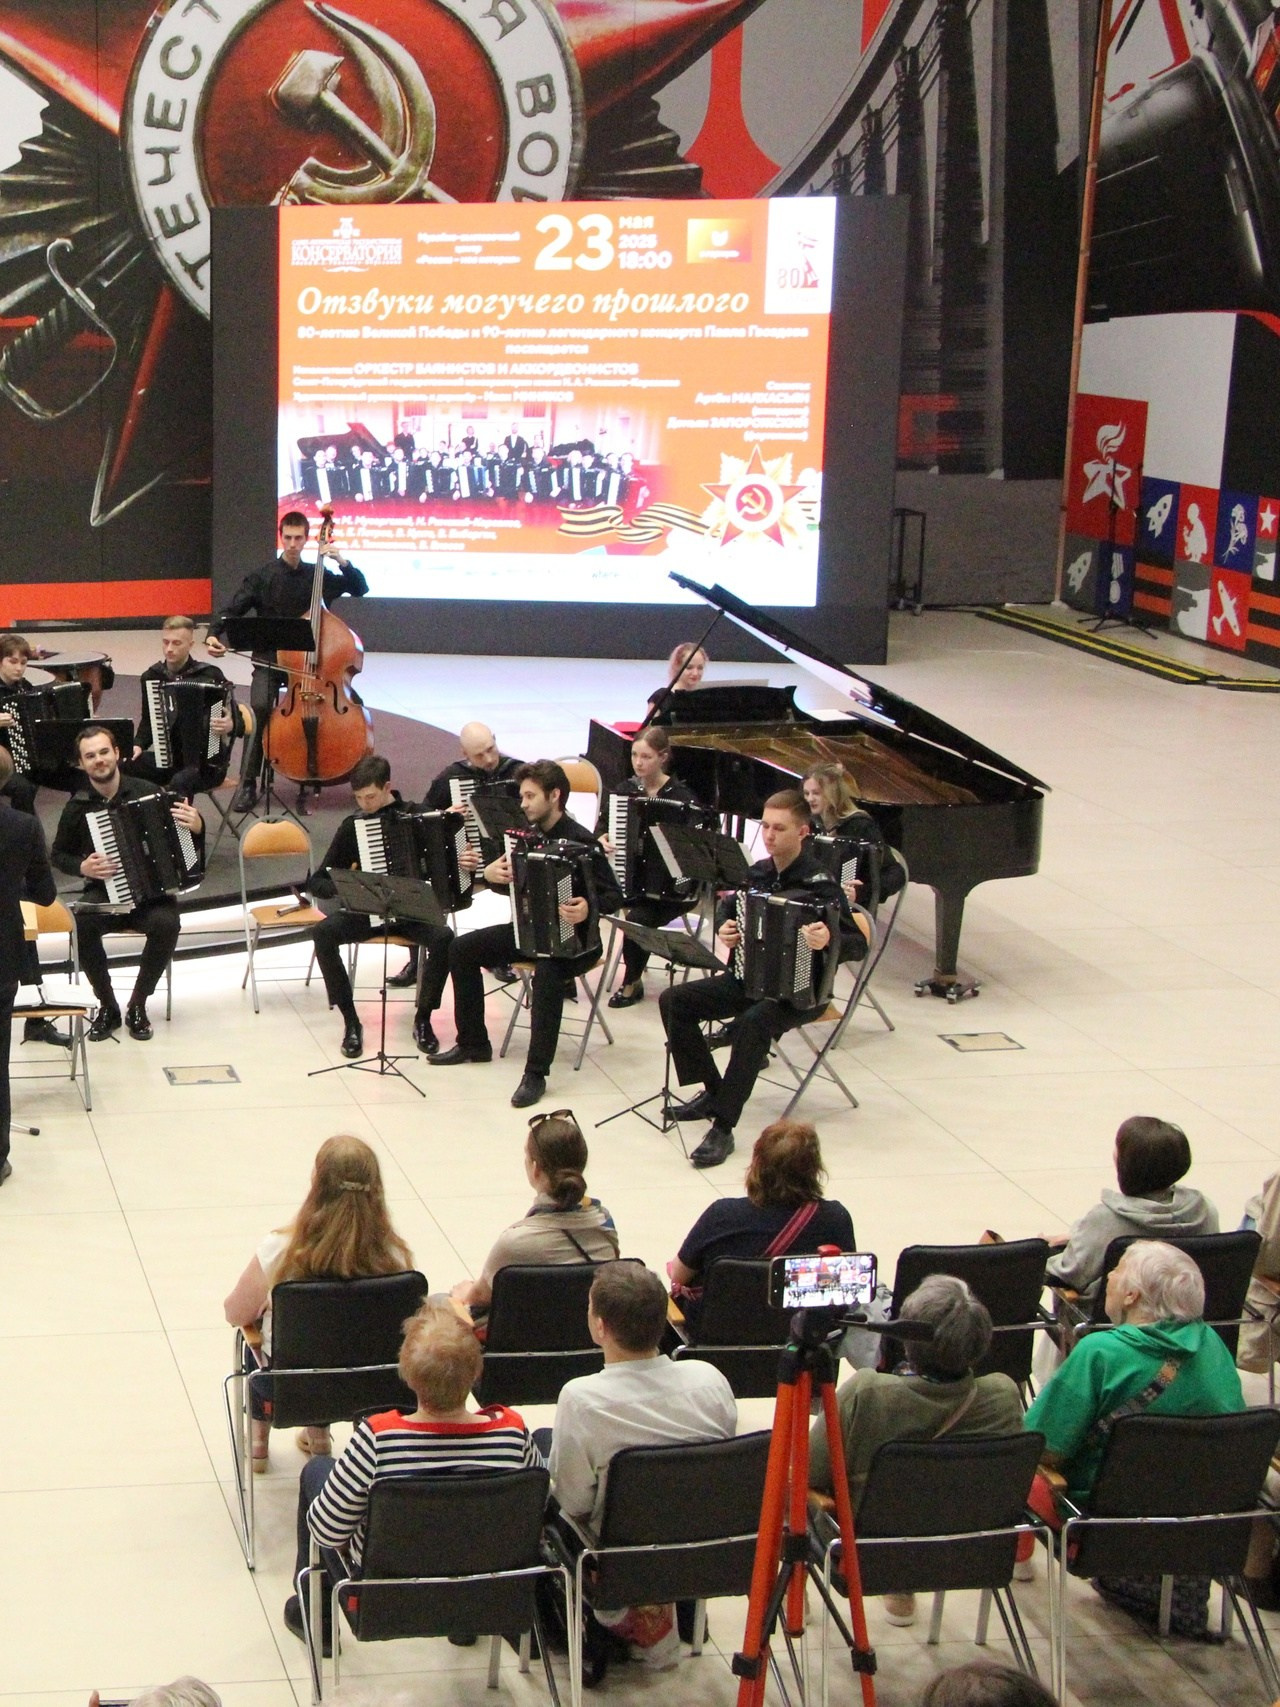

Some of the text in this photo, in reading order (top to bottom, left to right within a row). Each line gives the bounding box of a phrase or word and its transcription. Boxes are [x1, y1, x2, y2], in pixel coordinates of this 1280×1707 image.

[292, 244, 403, 263] КОНСЕРВАТОРИЯ
[533, 212, 615, 271] 23
[617, 250, 673, 269] 18:00
[297, 286, 750, 321] Отзвуки могучего прошлого
